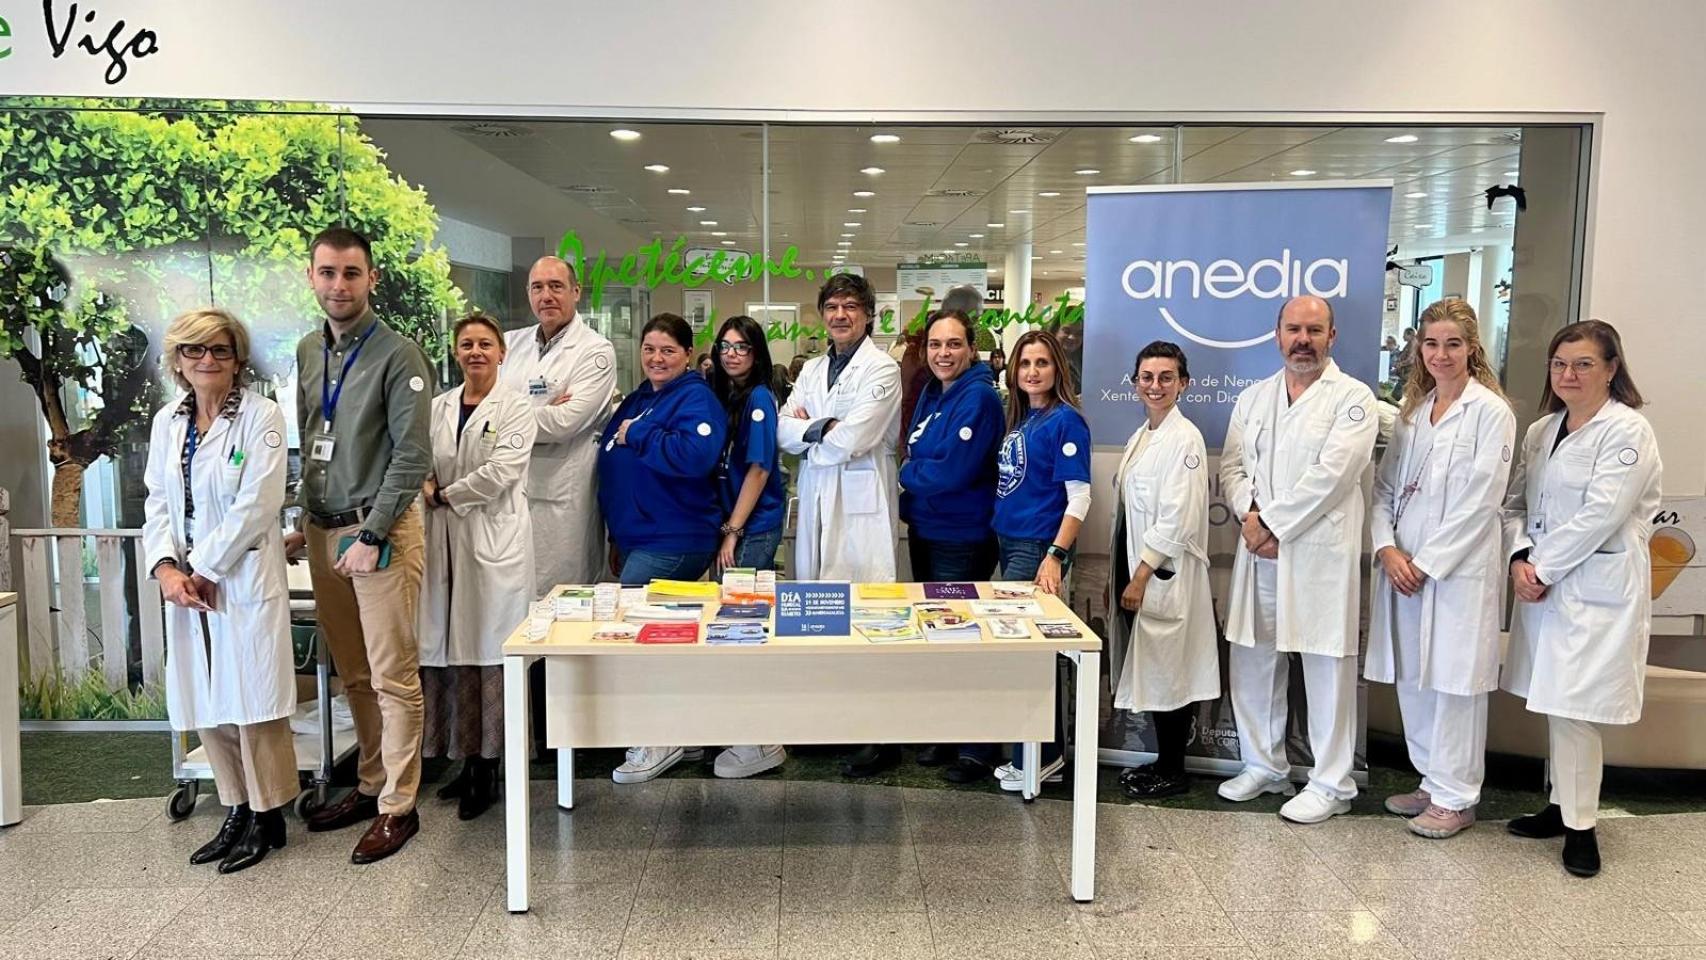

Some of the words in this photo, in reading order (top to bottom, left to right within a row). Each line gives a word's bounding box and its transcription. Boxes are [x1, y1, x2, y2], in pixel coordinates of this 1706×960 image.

[43, 0, 158, 84] Vigo
[1121, 248, 1348, 299] anedia
[1201, 374, 1219, 386] de
[1100, 389, 1140, 402] Xente
[1186, 392, 1211, 402] con
[1202, 726, 1237, 738] Deputa
